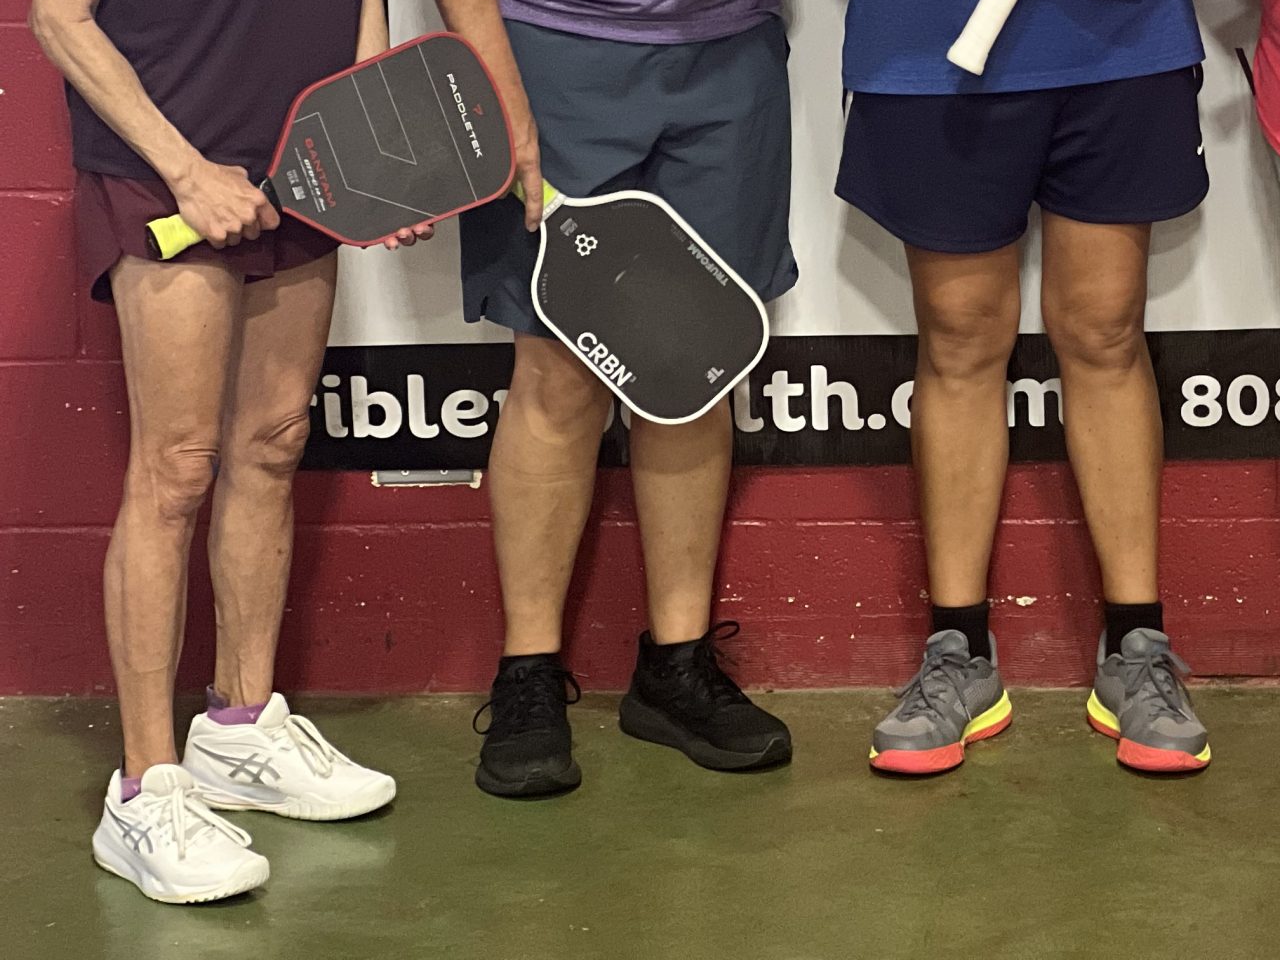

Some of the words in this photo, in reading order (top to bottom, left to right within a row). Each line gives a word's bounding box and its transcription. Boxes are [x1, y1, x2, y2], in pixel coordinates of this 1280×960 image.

[446, 72, 484, 159] PADDLETEK
[304, 137, 337, 209] BANTAM
[687, 243, 729, 287] TRUFOAM
[576, 331, 633, 388] CRBN
